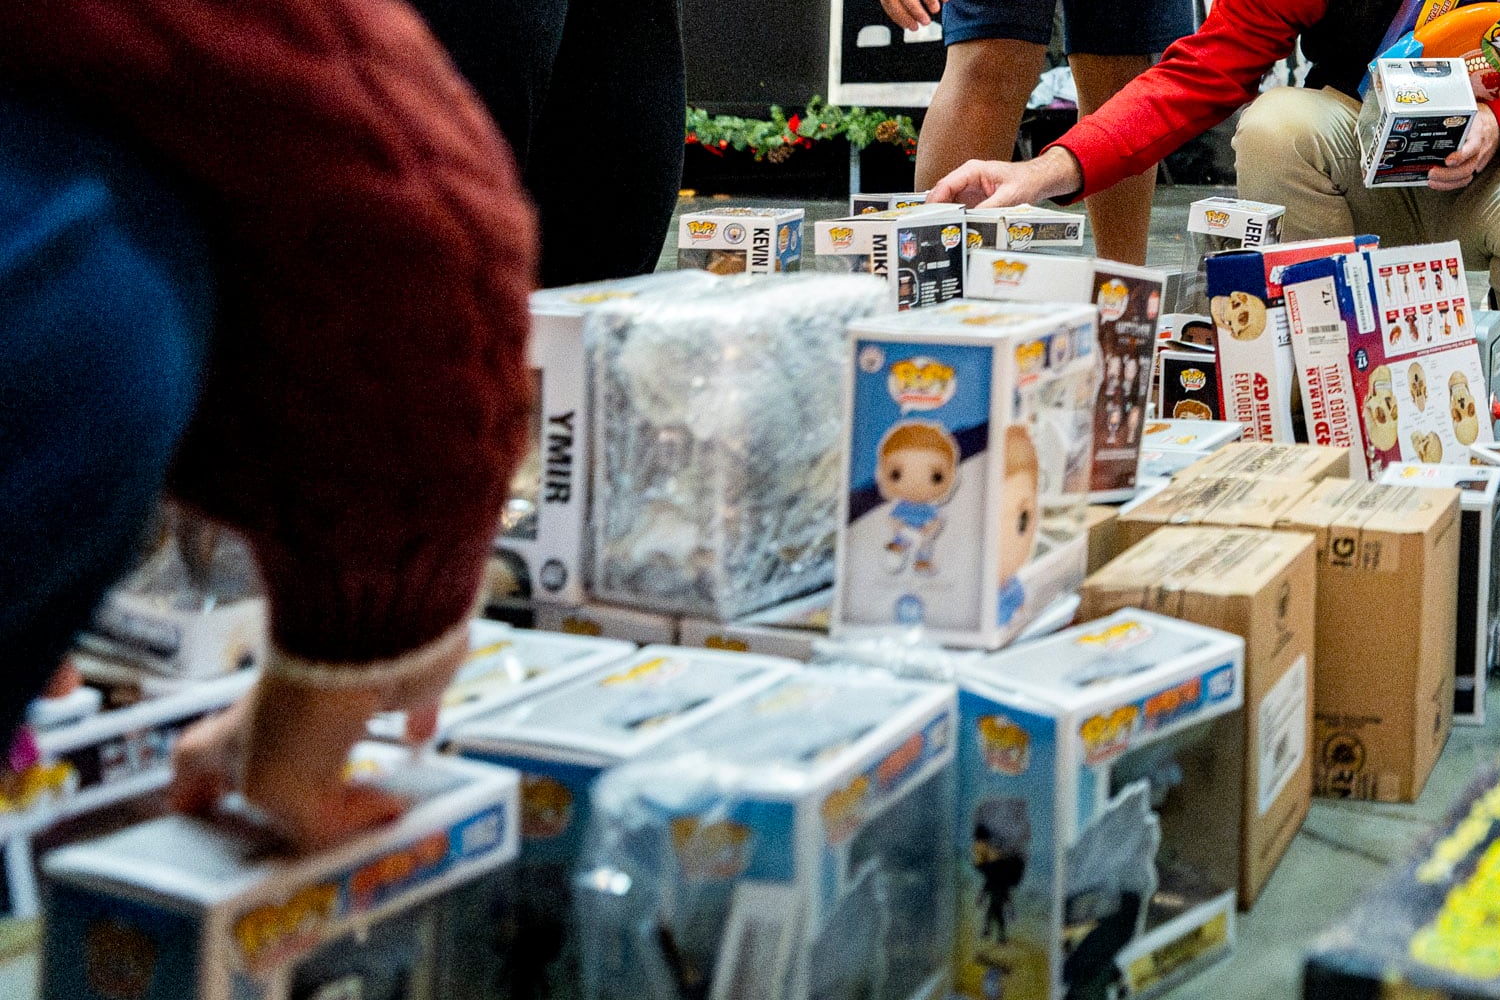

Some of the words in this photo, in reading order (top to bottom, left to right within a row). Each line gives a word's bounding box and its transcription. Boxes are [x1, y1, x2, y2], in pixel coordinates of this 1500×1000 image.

[686, 220, 717, 236] POP!
[1066, 224, 1079, 238] 09
[753, 227, 770, 267] KEVIN
[1321, 289, 1333, 305] 17
[1306, 366, 1325, 421] HUMAN
[1323, 363, 1344, 394] SKULL
[1262, 402, 1274, 443] HUM
[546, 411, 575, 505] YMIR
